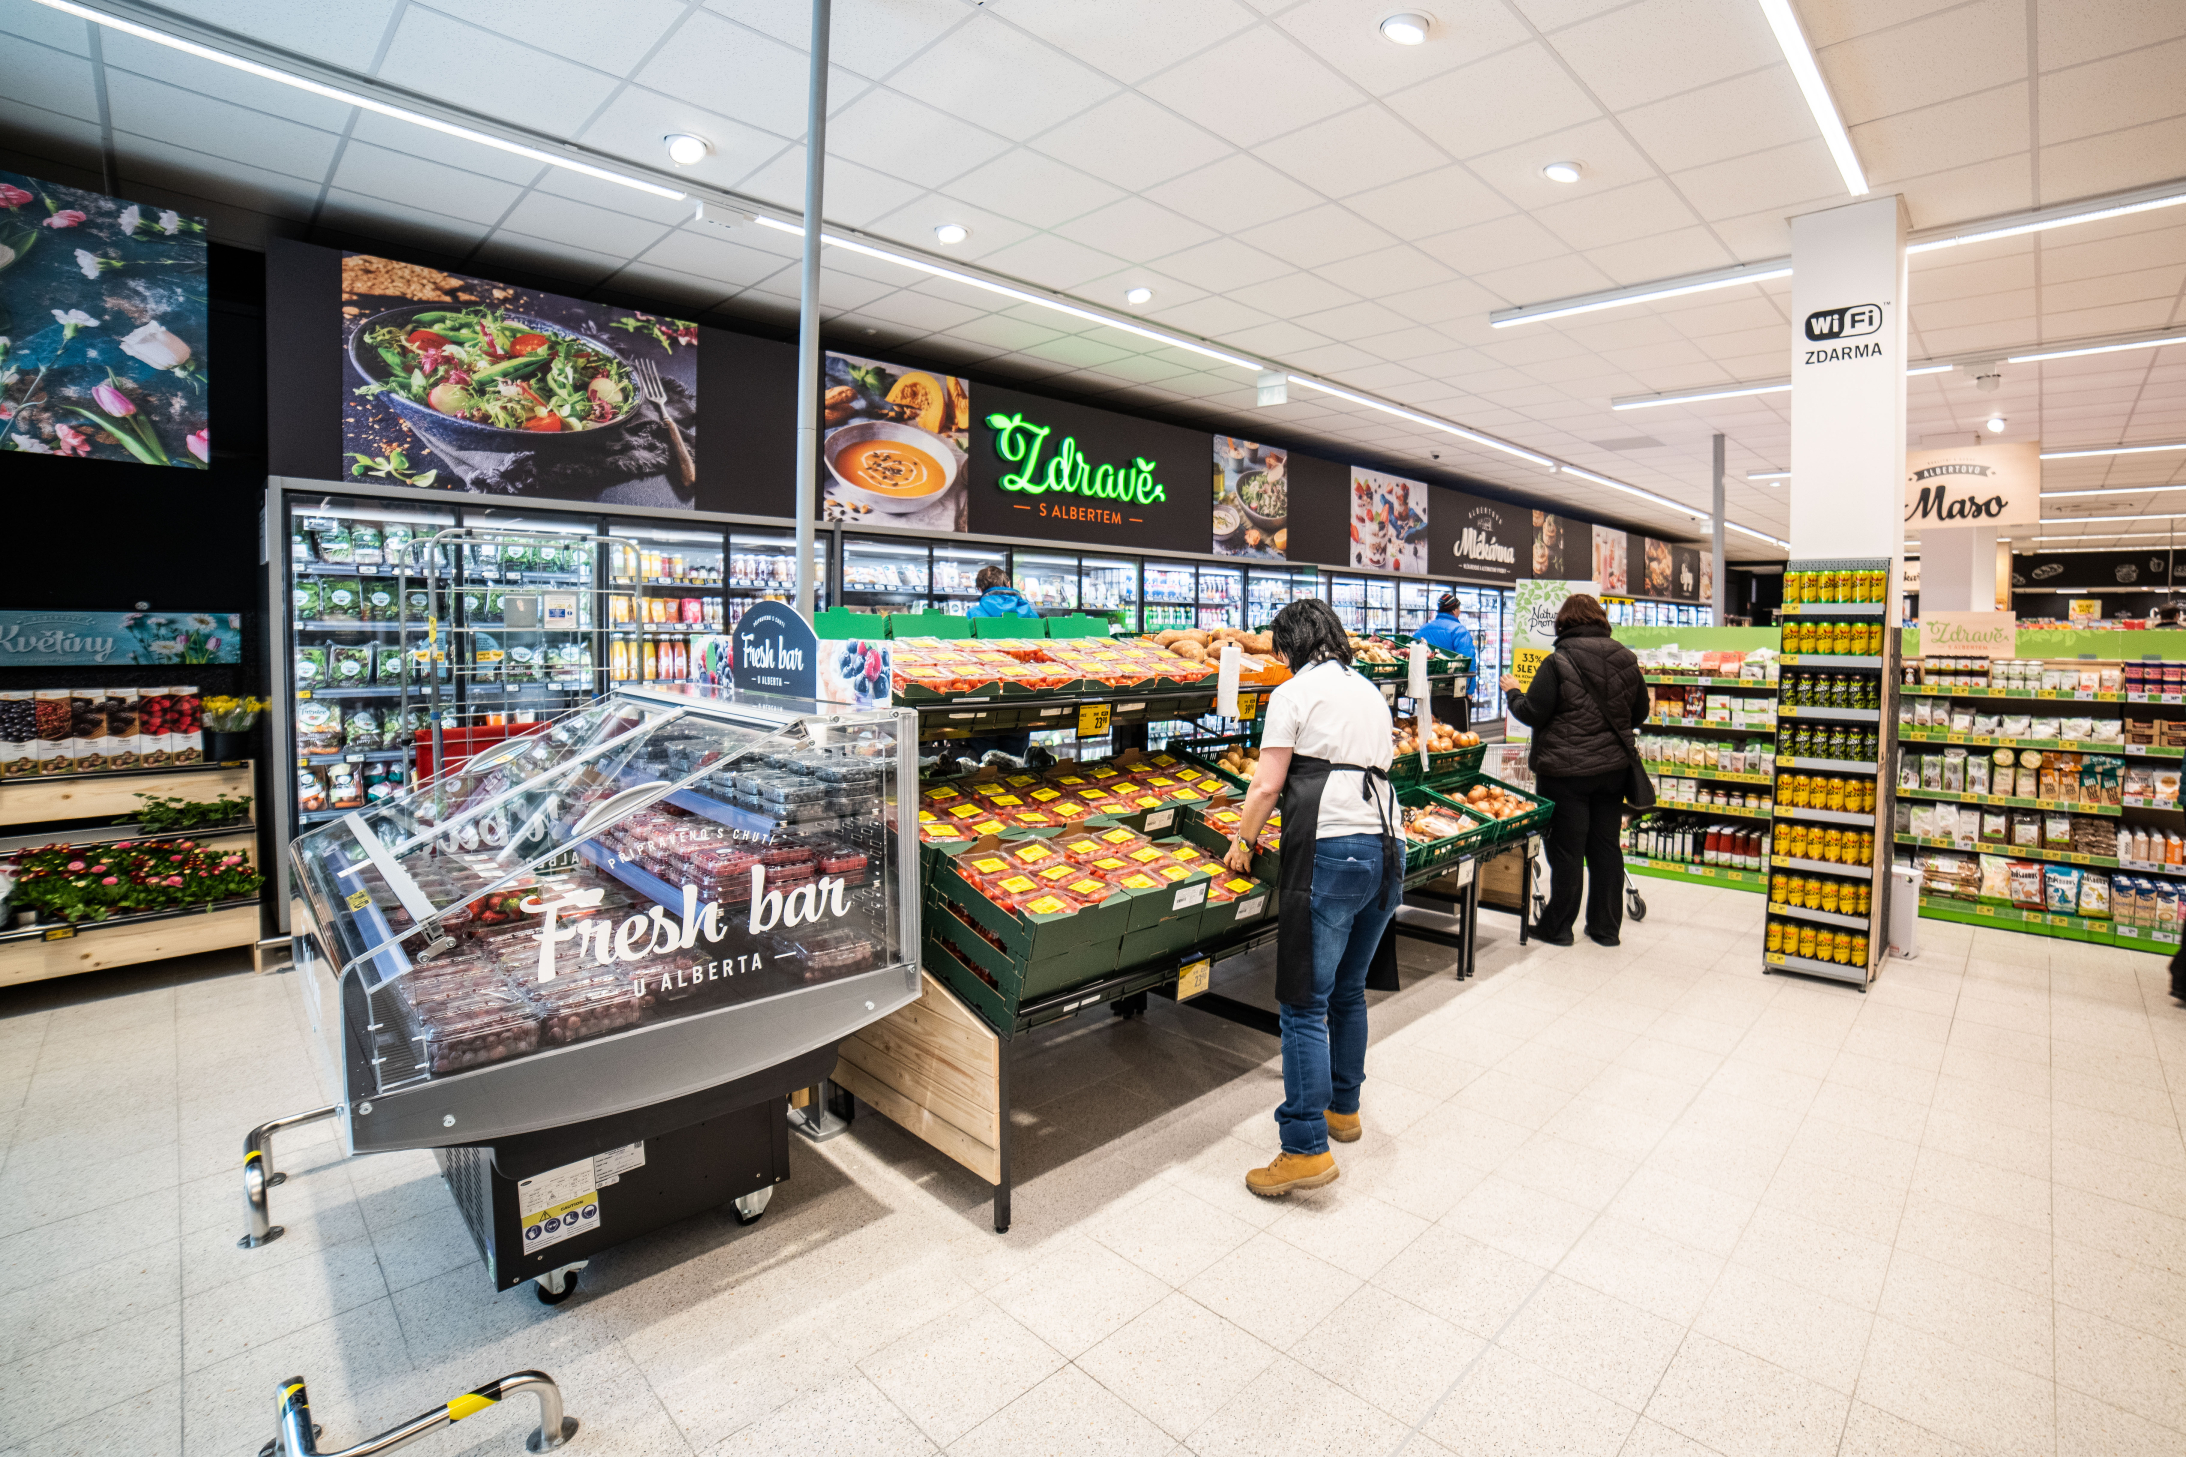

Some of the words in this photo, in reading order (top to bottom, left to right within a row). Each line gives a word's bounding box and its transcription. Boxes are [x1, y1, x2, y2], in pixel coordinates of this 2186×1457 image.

[1804, 342, 1883, 366] ZDARMA
[985, 413, 1166, 505] Zdravě
[1923, 465, 1981, 478] ALBERTOVO
[1039, 503, 1047, 516] S
[1051, 505, 1122, 525] ALBERTEM
[1904, 485, 2008, 521] Maso
[1453, 527, 1515, 564] Mlékárna
[1532, 604, 1558, 620] Natur
[0, 625, 116, 663] Květiny
[1926, 620, 2009, 644] Zdravě
[741, 632, 776, 670] Fresh
[778, 635, 804, 671] bar
[1522, 653, 1543, 664] 33%
[761, 675, 782, 687] ALBERTA
[607, 829, 708, 870] PŘIPRAVENO
[717, 828, 724, 839] S
[732, 828, 775, 847] CHUTÍ
[519, 884, 728, 983] Fresh
[748, 864, 852, 935] bar
[634, 979, 646, 997] U
[660, 953, 763, 992] ALBERTA
[560, 1200, 584, 1212] CAUTION
